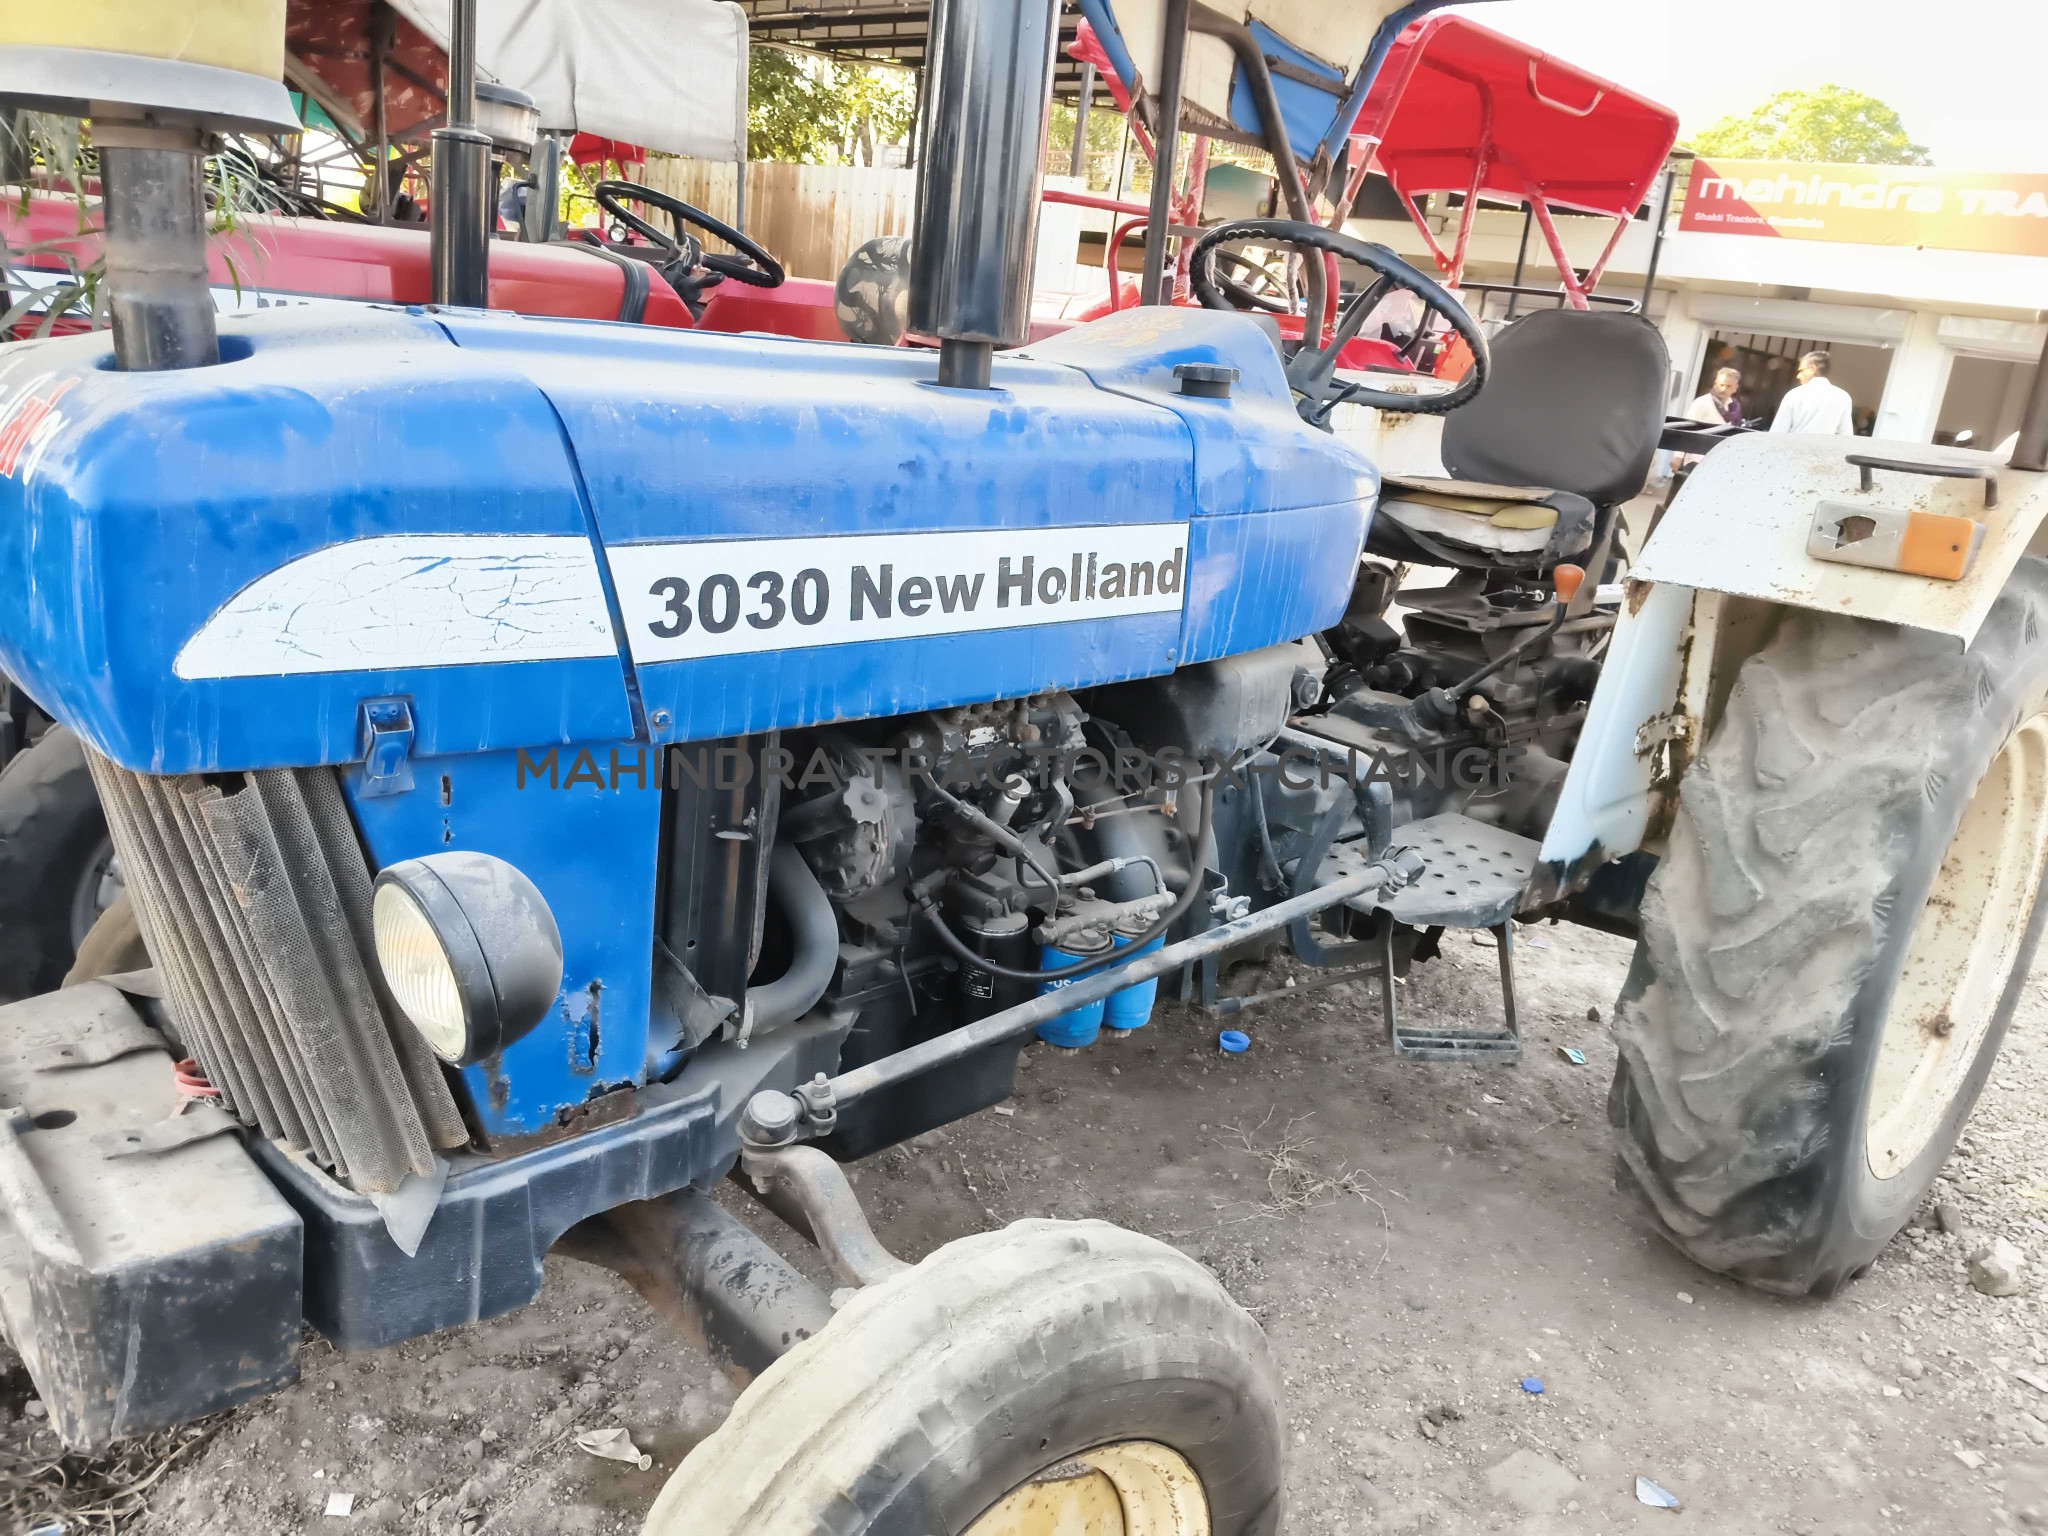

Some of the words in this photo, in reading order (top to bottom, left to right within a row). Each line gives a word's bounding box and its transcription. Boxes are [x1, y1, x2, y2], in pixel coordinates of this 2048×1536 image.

[1699, 172, 1944, 212] mahindra
[1694, 212, 1723, 222] Shakti
[648, 568, 830, 639] 3030
[850, 564, 985, 622] New
[996, 547, 1184, 609] Holland
